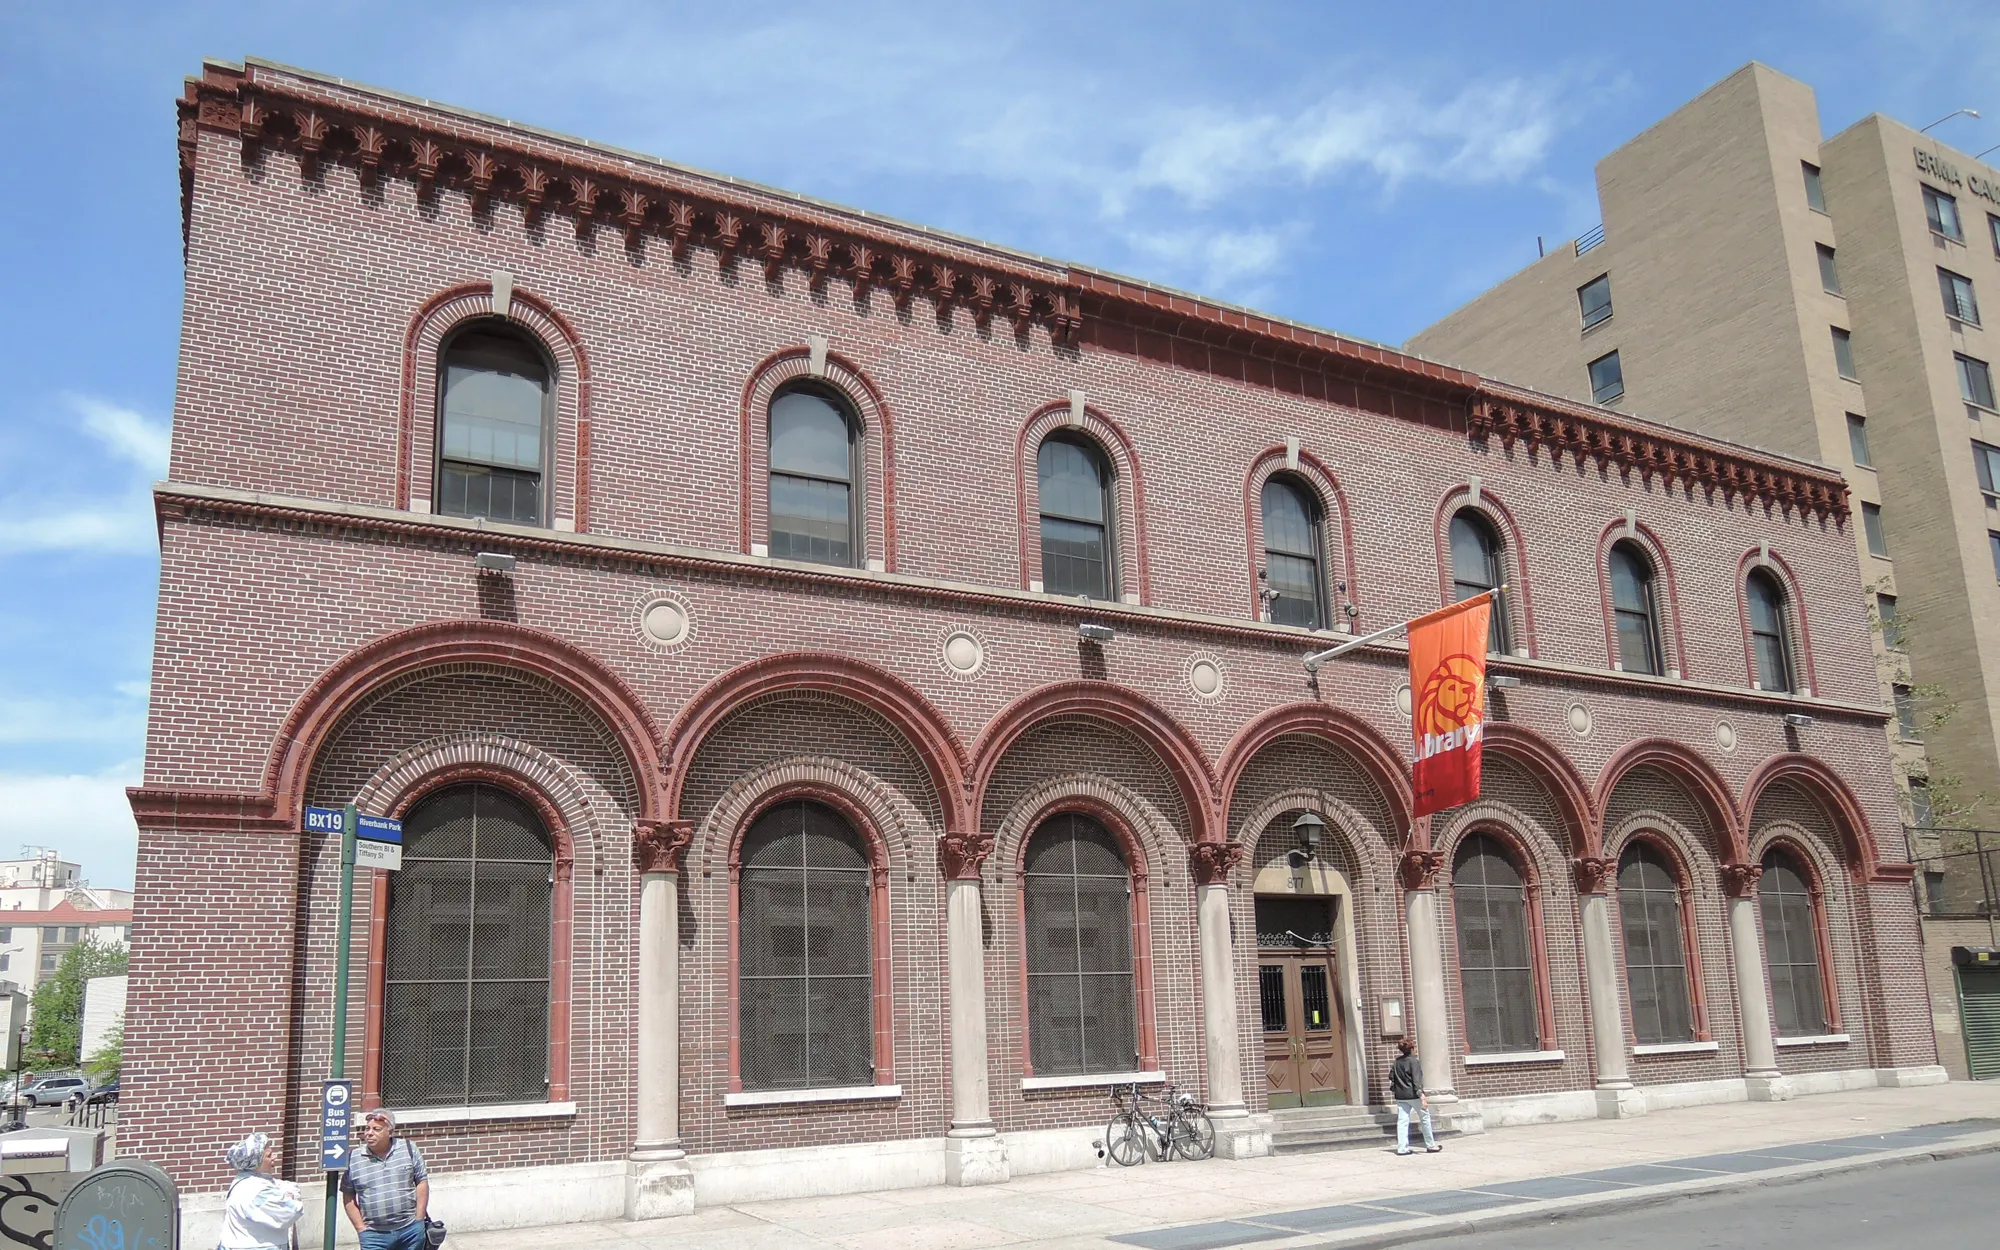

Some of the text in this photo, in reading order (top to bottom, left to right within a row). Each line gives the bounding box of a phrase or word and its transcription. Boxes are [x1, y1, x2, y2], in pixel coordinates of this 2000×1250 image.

[1913, 147, 1962, 189] ERMA
[309, 813, 342, 830] BX19
[359, 818, 402, 831] Riverbank Park
[358, 842, 384, 851] Southern
[358, 850, 377, 859] Tiffany
[1287, 877, 1304, 889] 877
[328, 1108, 345, 1117] Bus
[325, 1118, 346, 1127] Stop
